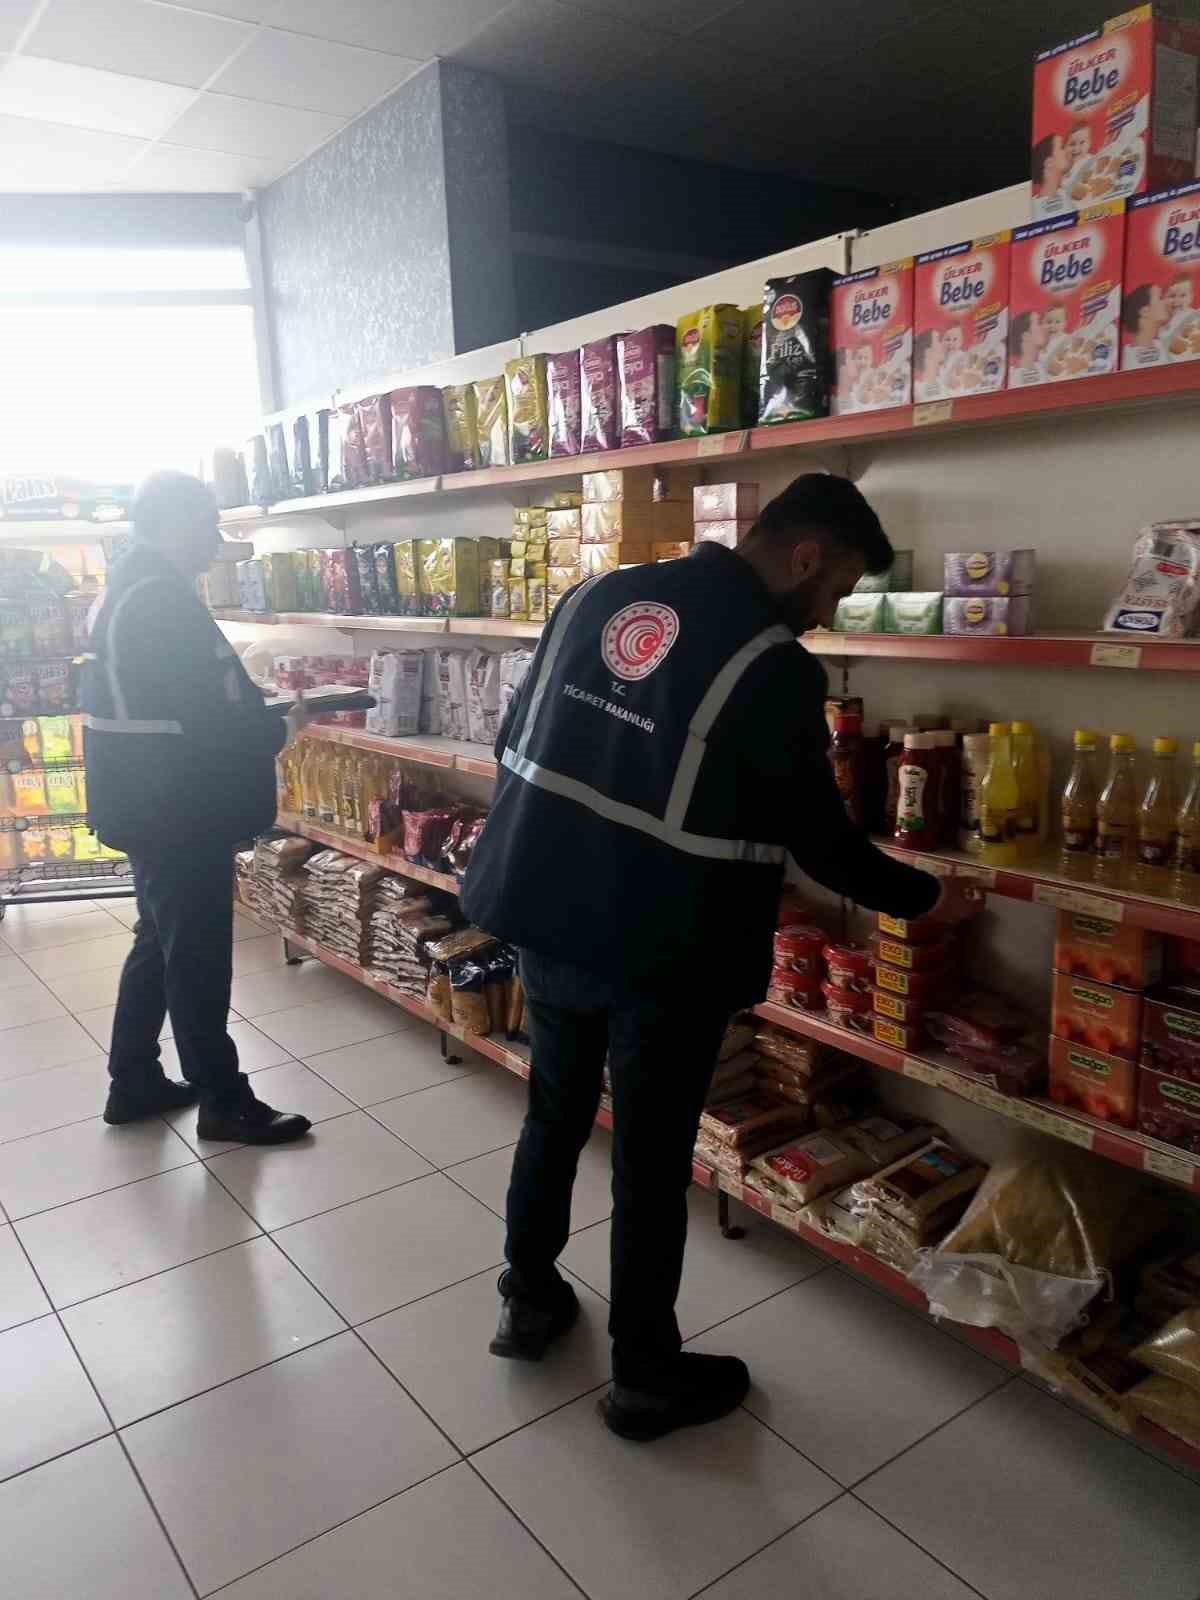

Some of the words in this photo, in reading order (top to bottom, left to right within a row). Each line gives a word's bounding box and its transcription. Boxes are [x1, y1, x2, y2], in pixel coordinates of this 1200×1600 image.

[1067, 47, 1117, 77] ÜLKER
[1063, 67, 1120, 106] Bebe
[1043, 237, 1091, 259] ÜLKER
[943, 262, 983, 281] ÜLKER
[1040, 253, 1094, 286] Bebe
[854, 286, 889, 302] ÜLKER
[939, 277, 985, 306] Bebe
[851, 300, 892, 326] Bebe
[767, 340, 802, 364] Filiz
[562, 683, 606, 709] TİCARET
[604, 701, 656, 734] BAKANLIĞI
